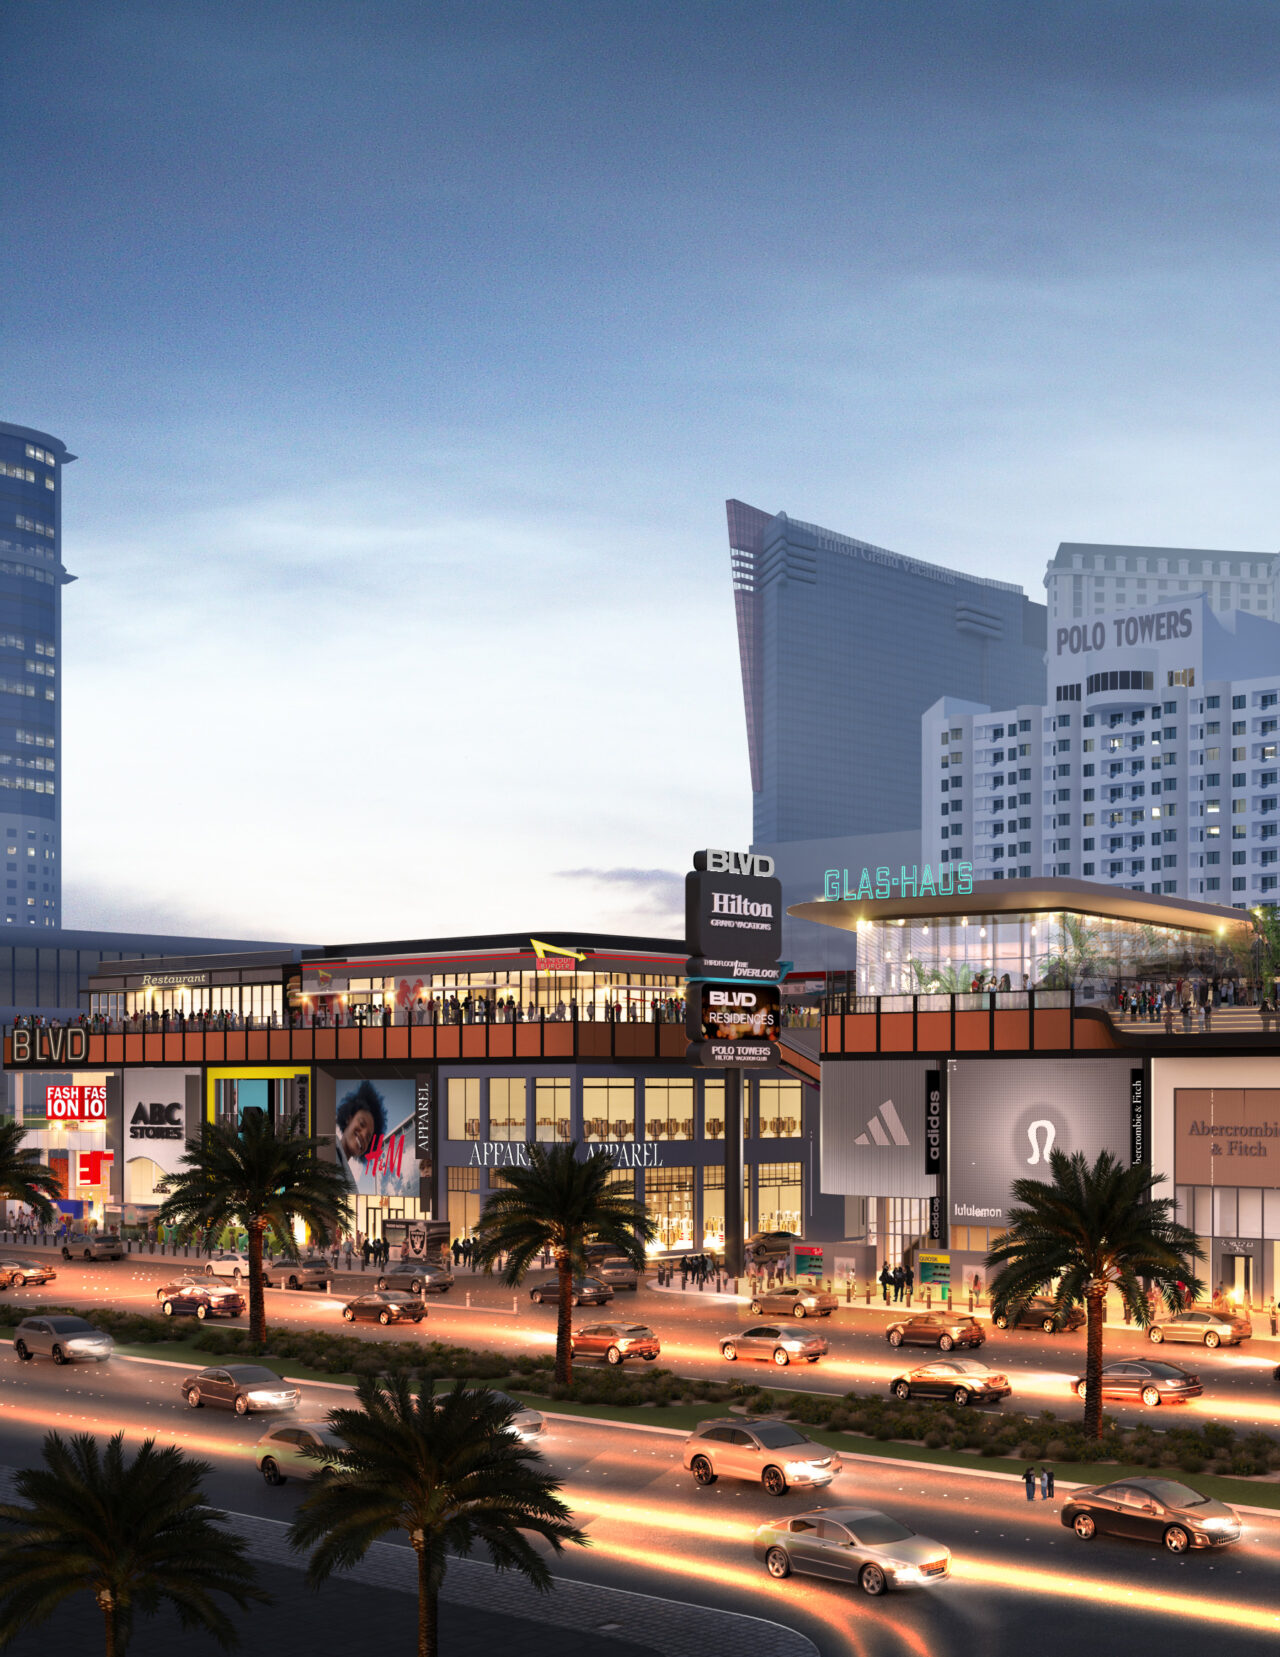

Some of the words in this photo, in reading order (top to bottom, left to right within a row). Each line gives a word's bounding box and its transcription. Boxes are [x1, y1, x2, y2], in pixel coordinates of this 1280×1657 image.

[817, 534, 858, 558] Hilton
[860, 547, 899, 569] Grand
[900, 559, 956, 586] Vacations
[1056, 621, 1106, 656] POLO
[1113, 608, 1193, 648] TOWERS
[706, 848, 775, 877] BLVD
[711, 892, 774, 918] Hilton
[710, 919, 735, 928] GRAND
[735, 921, 772, 931] VACATIONS
[142, 974, 206, 985] Restaurant
[736, 968, 779, 978] OVERLOOK
[709, 990, 757, 1007] BLVD
[709, 1012, 775, 1025] RESIDENCES
[13, 1028, 87, 1061] BLVD
[711, 1046, 735, 1055] POLO
[736, 1046, 771, 1056] TOWERS
[47, 1087, 79, 1099] FASH
[84, 1087, 107, 1099] FAS
[1132, 1080, 1142, 1104] Fitch
[47, 1099, 79, 1117] ION
[84, 1099, 107, 1117] IO
[130, 1101, 183, 1126] ABC
[417, 1082, 430, 1152] APPAREL
[1134, 1105, 1142, 1113] &
[129, 1126, 184, 1139] STORES
[927, 1090, 940, 1160] adidas
[1132, 1113, 1143, 1166] bercrombie
[1210, 1143, 1223, 1156] &
[1226, 1140, 1267, 1157] Fitch
[364, 1133, 406, 1179] H&M
[469, 1142, 532, 1166] APPAR
[586, 1143, 664, 1167] APPAREL
[929, 1197, 940, 1239] adidas
[954, 1203, 1002, 1218] lululemon
